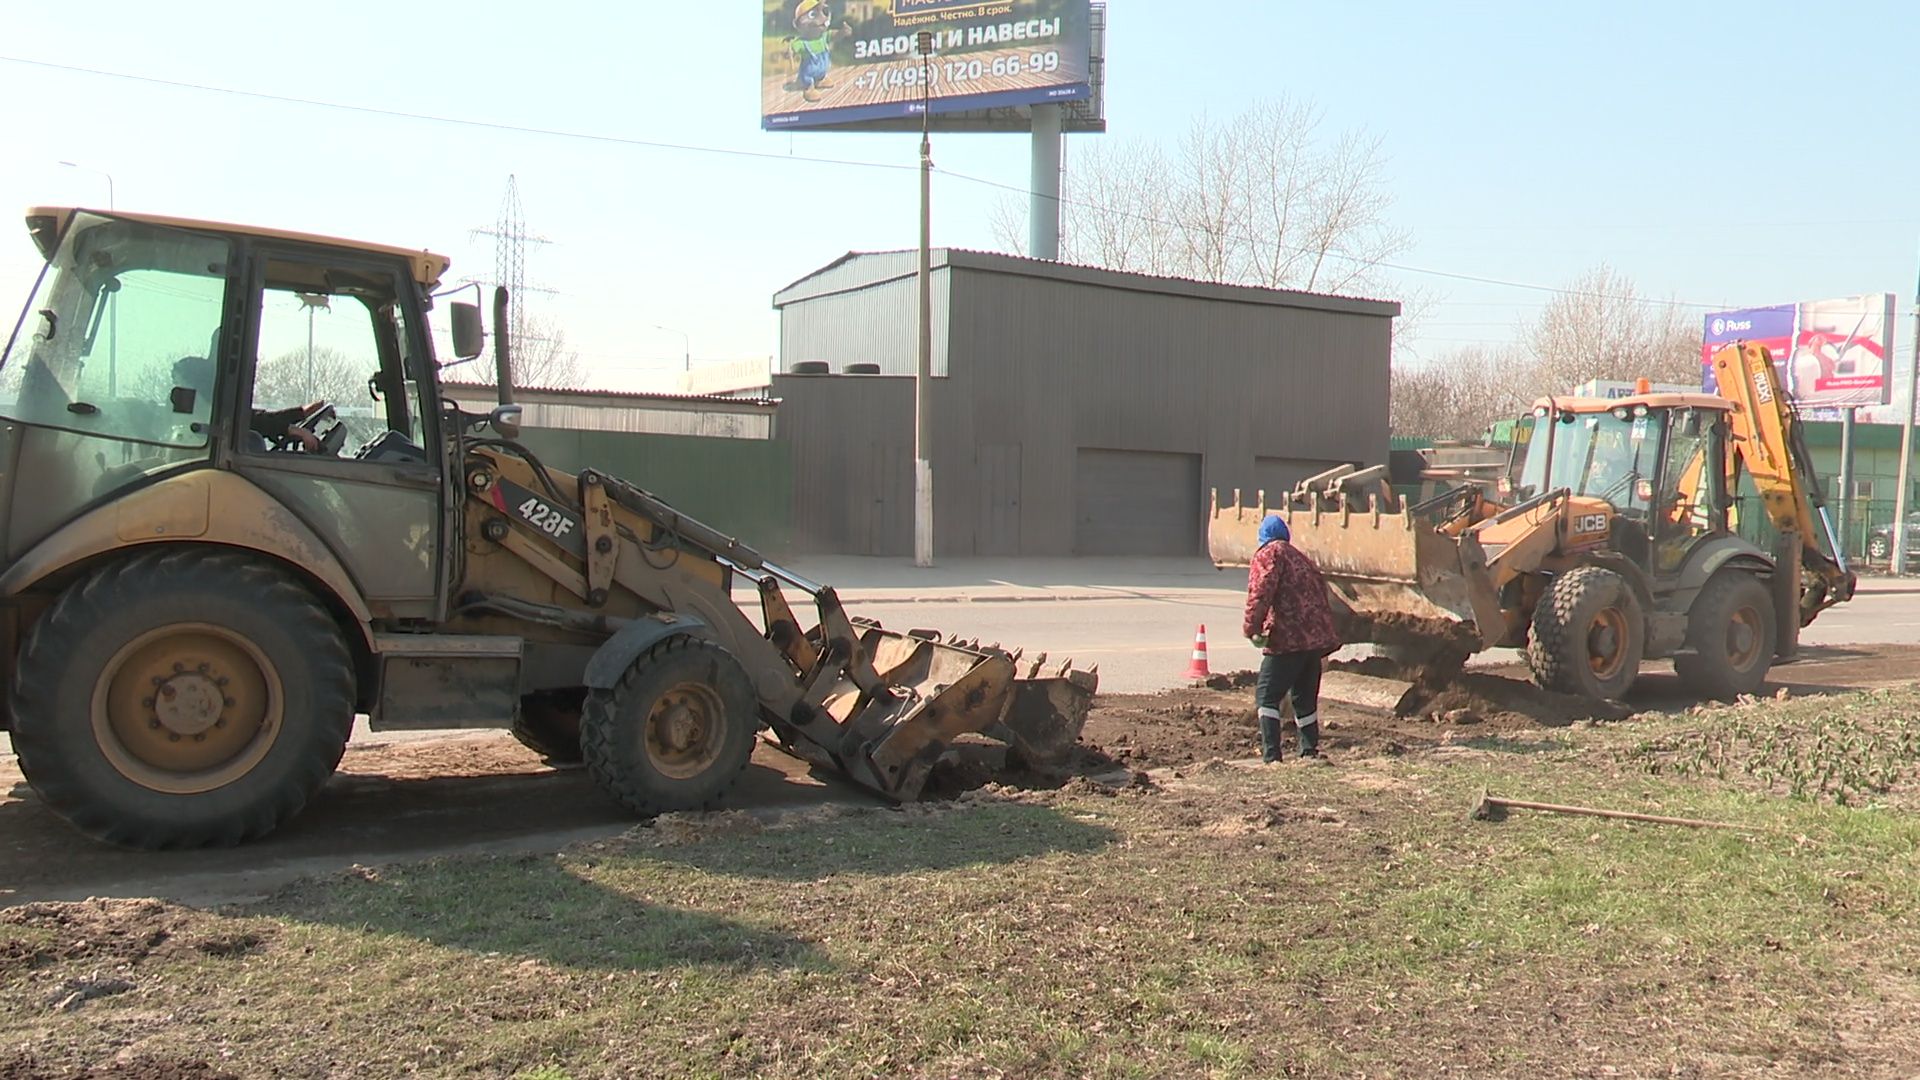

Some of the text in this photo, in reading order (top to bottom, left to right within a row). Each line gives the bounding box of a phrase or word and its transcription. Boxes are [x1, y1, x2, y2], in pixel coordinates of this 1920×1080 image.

[894, 5, 1012, 27] Надёжно. Честно. В срок.
[947, 28, 963, 47] И
[967, 17, 1061, 46] НАВЕСЫ
[855, 70, 880, 90] +7
[943, 51, 1060, 83] 120-66-99
[1726, 319, 1752, 331] Russ
[518, 497, 575, 538] 428F
[1575, 513, 1607, 532] JCB
